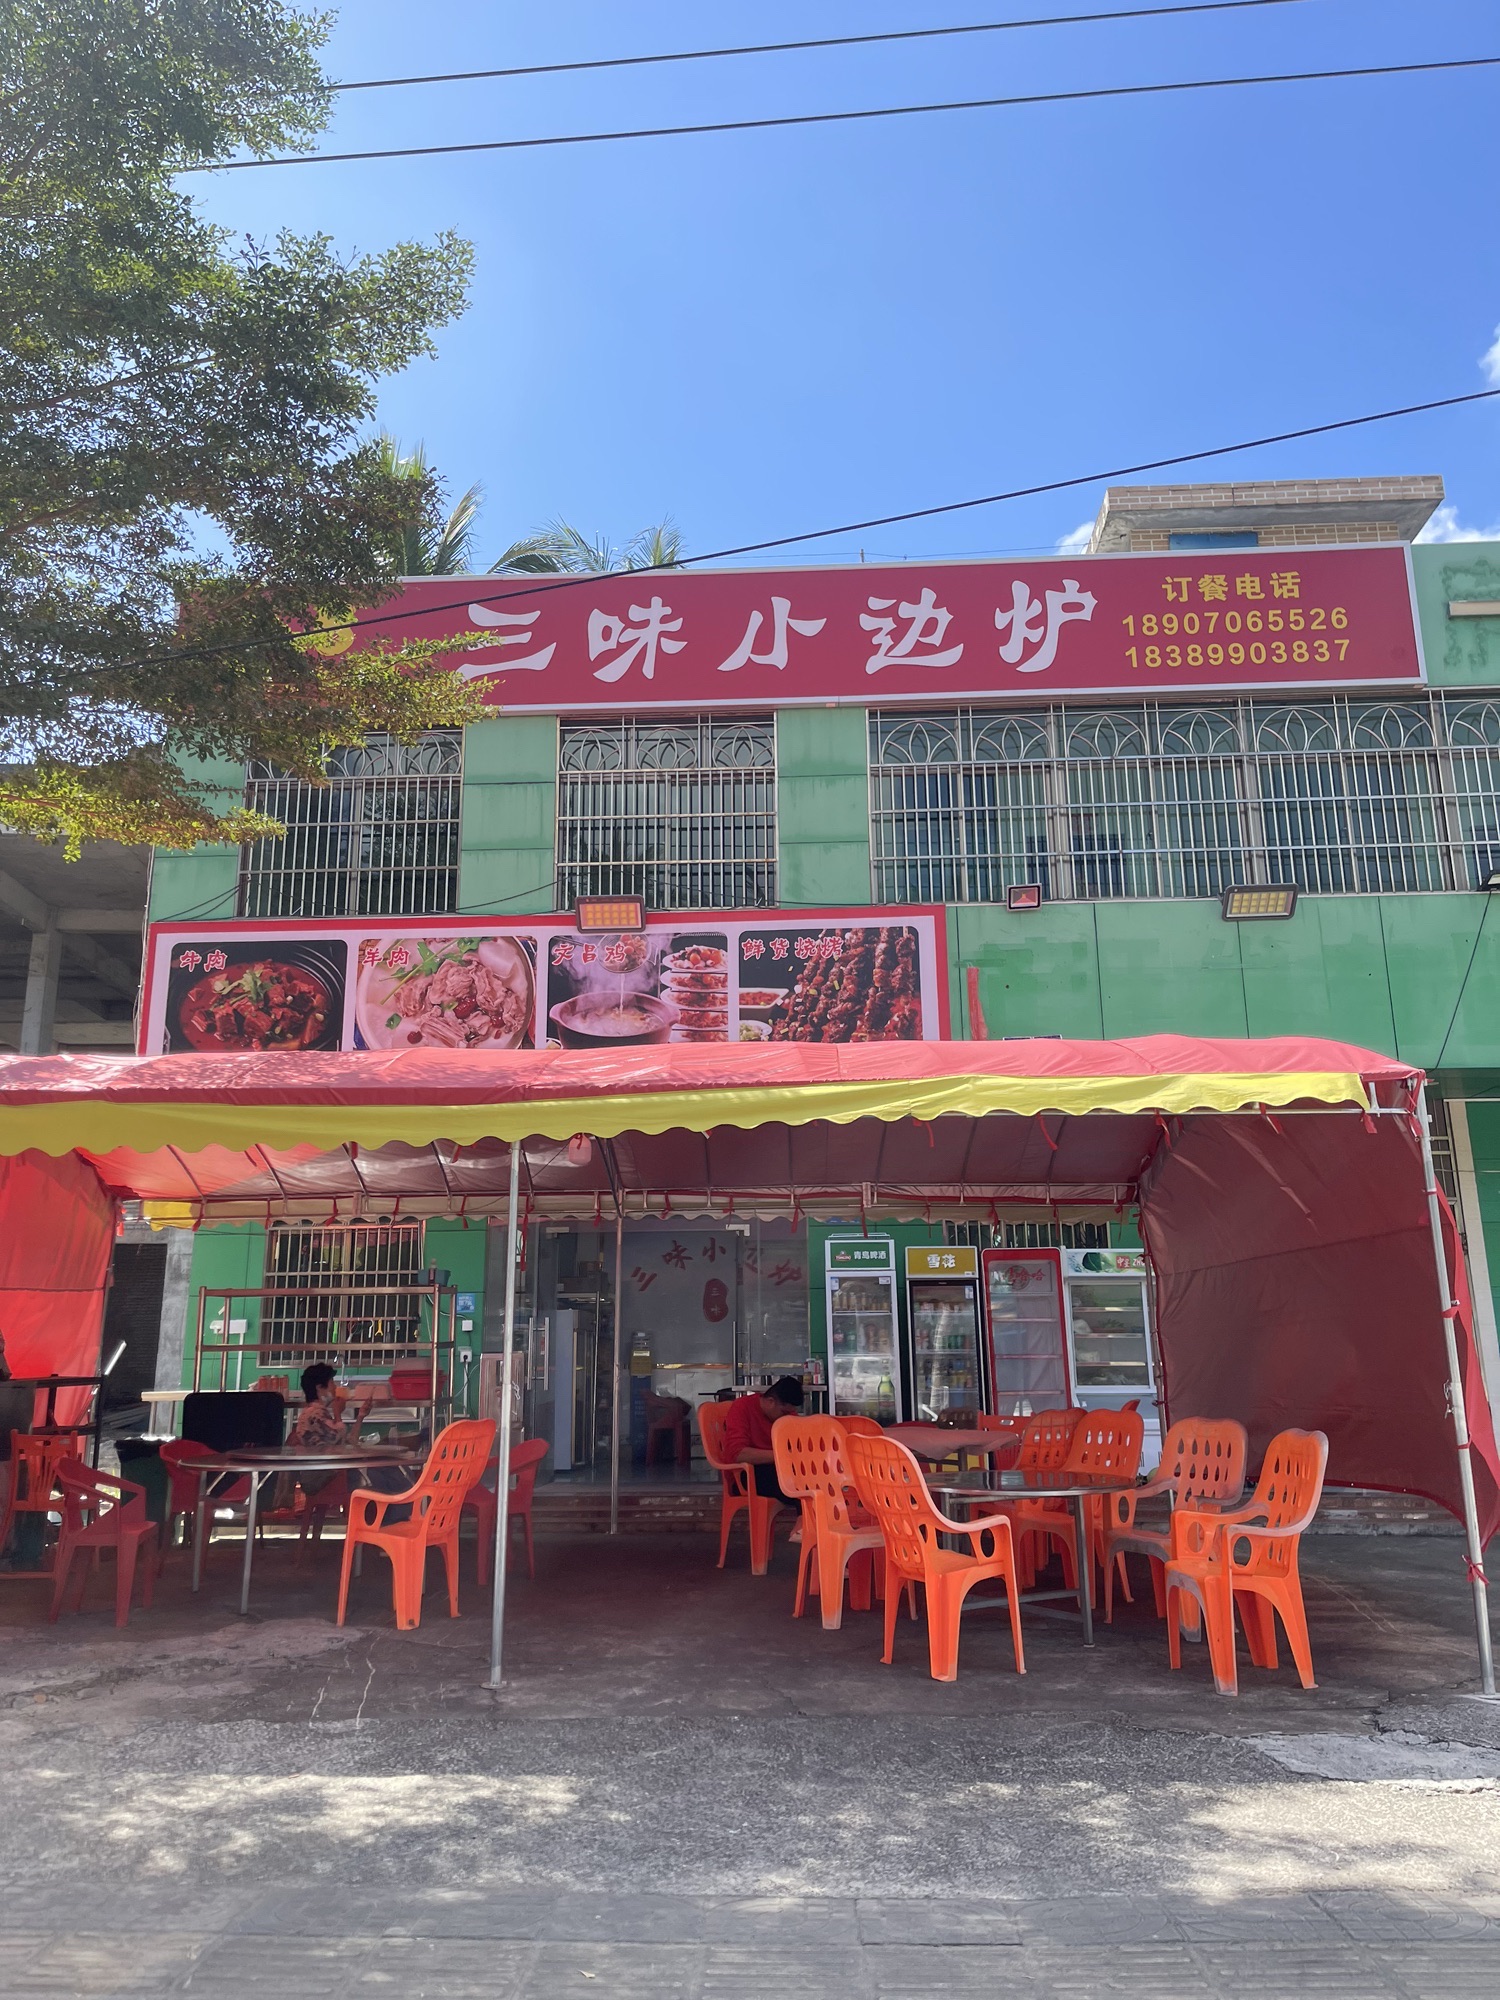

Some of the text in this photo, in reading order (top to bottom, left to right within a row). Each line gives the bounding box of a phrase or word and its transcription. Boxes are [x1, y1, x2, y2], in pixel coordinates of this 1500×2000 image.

[1162, 571, 1301, 603] 订餐电话
[456, 579, 1098, 683] 三味小边炉
[1122, 607, 1349, 637] 18907065526
[1124, 639, 1350, 668] 18389903837
[361, 946, 410, 968] 羊肉
[552, 942, 627, 965] 文昌鸡
[741, 936, 844, 960] 鲜货烧烤
[179, 949, 228, 972] 牛肉
[853, 1251, 887, 1260] 青岛啤酒
[926, 1253, 956, 1269] 雪花
